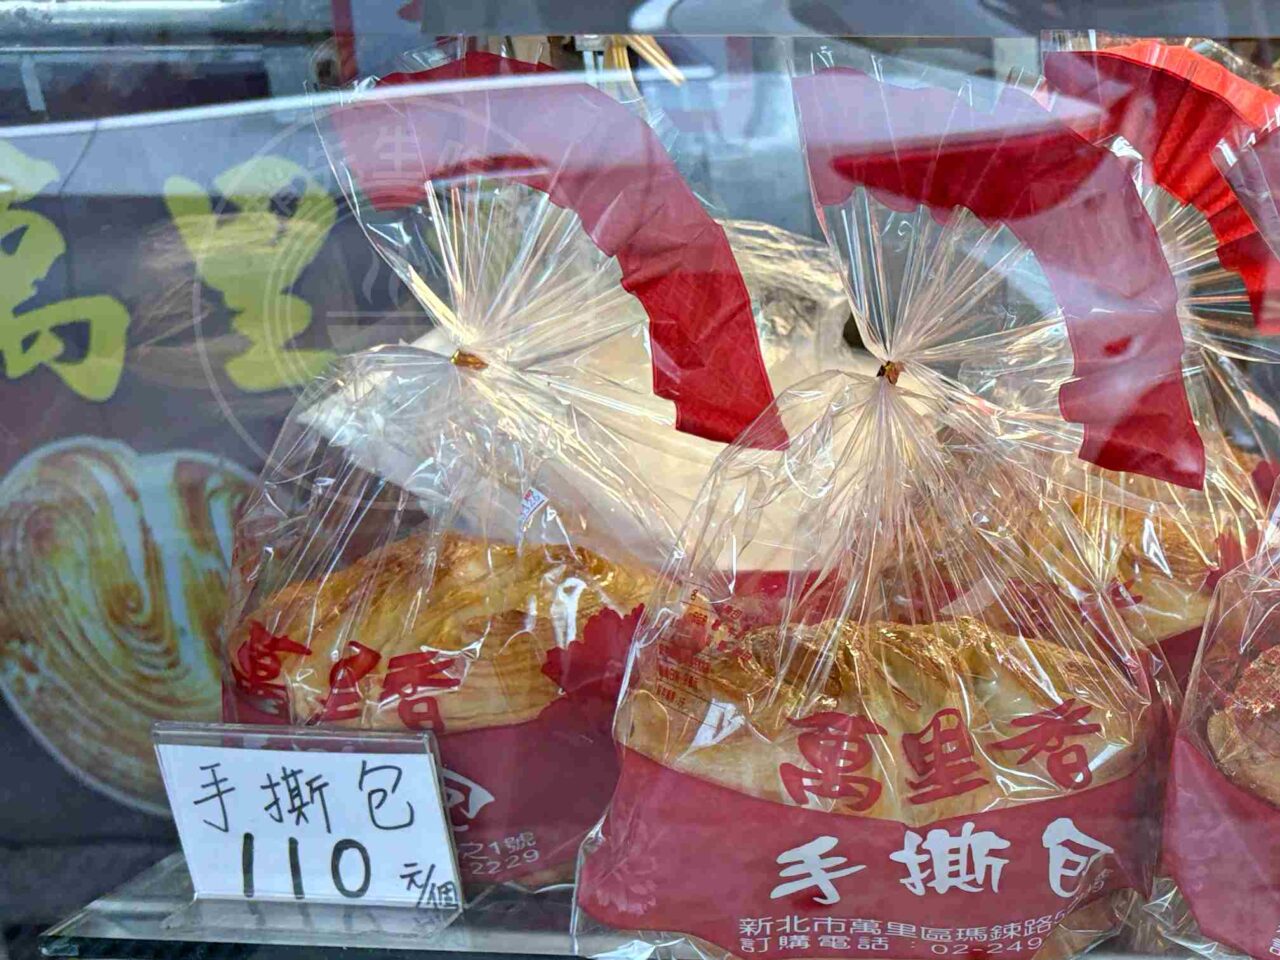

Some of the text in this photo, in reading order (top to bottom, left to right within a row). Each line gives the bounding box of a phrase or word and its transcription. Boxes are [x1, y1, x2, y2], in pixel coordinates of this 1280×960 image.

[777, 697, 1101, 812] 萬里香
[193, 760, 415, 834] 手撕包
[242, 832, 371, 898] 110
[770, 817, 1115, 905] 手撕包
